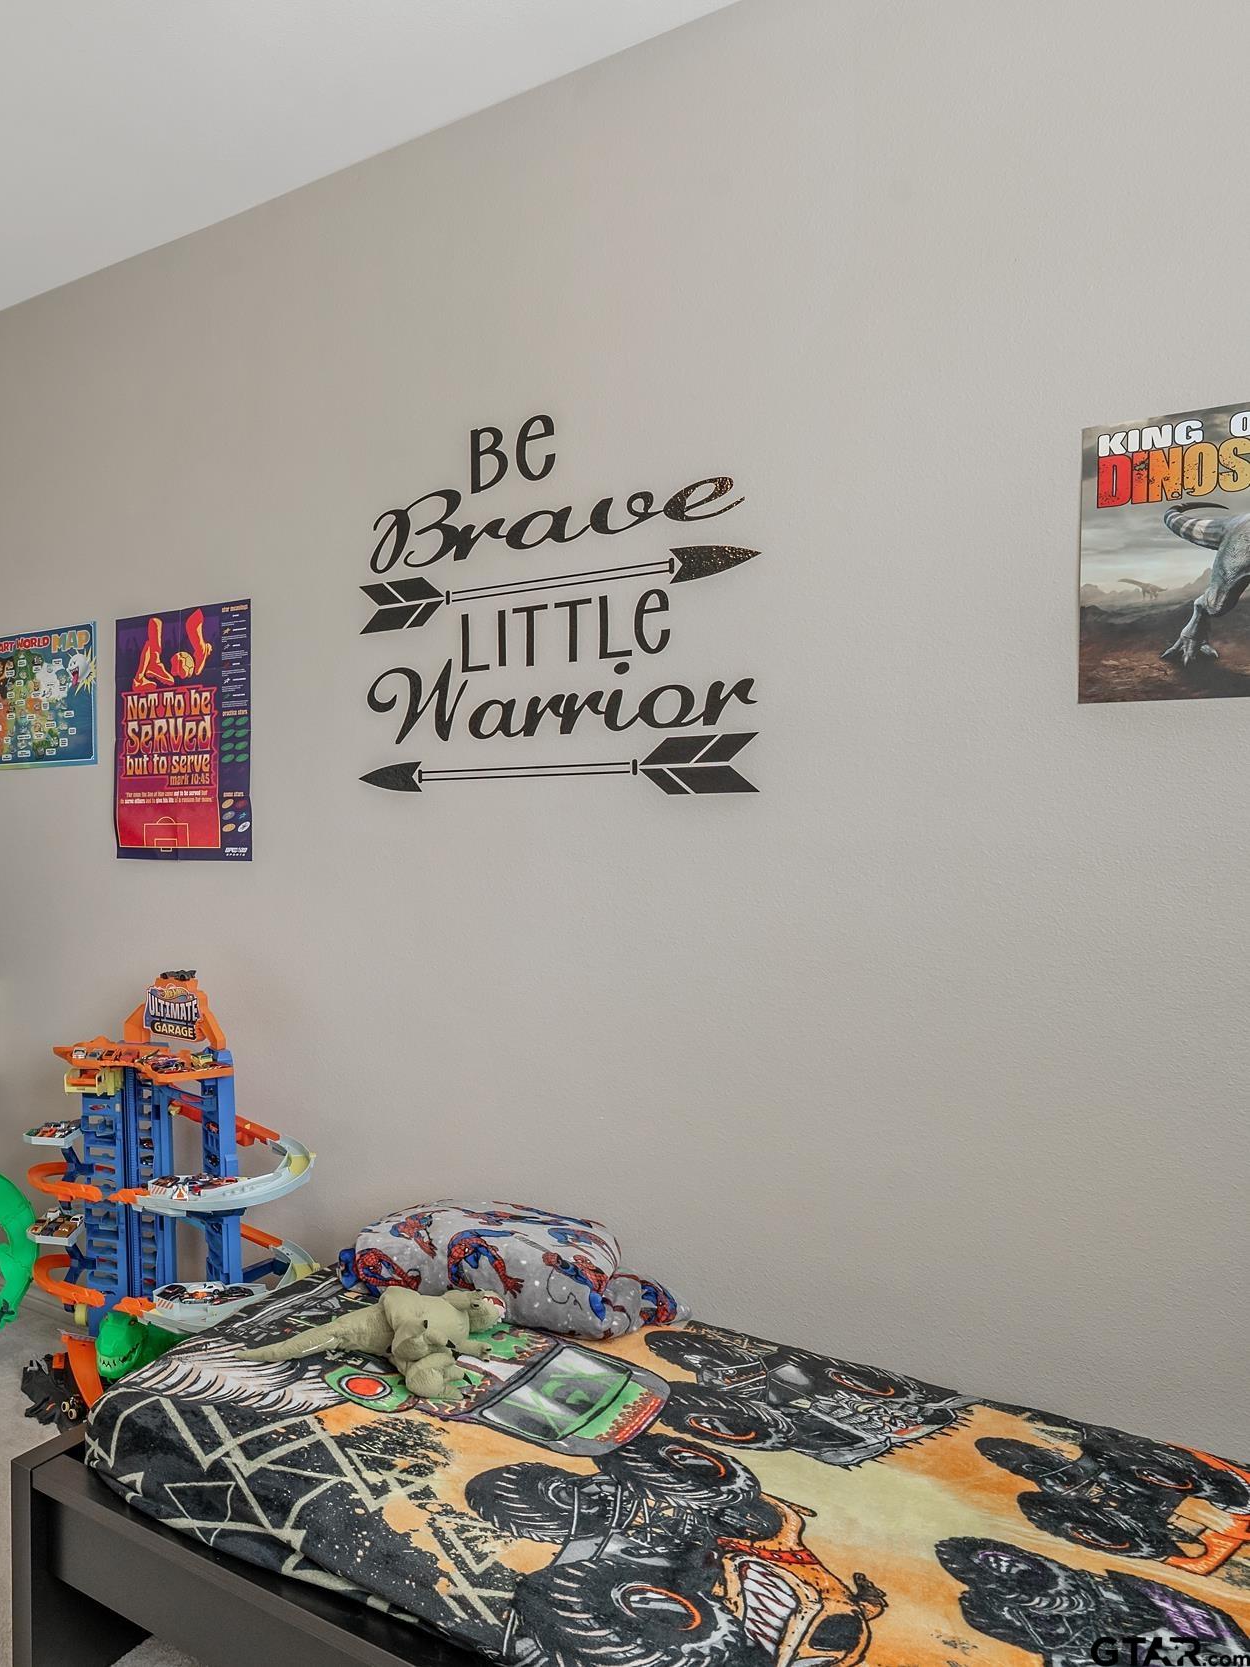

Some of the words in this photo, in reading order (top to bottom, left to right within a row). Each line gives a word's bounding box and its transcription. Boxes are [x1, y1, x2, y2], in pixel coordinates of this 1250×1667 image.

[1098, 419, 1204, 458] KING
[369, 476, 746, 575] Brave
[15, 635, 50, 649] WORLD
[51, 630, 91, 653] MAP
[366, 659, 759, 745] Warrior
[126, 754, 149, 776] but
[153, 754, 168, 774] to
[171, 753, 210, 774] serve
[148, 992, 198, 1021] ULTIMATE
[154, 1022, 194, 1038] GARAGE
